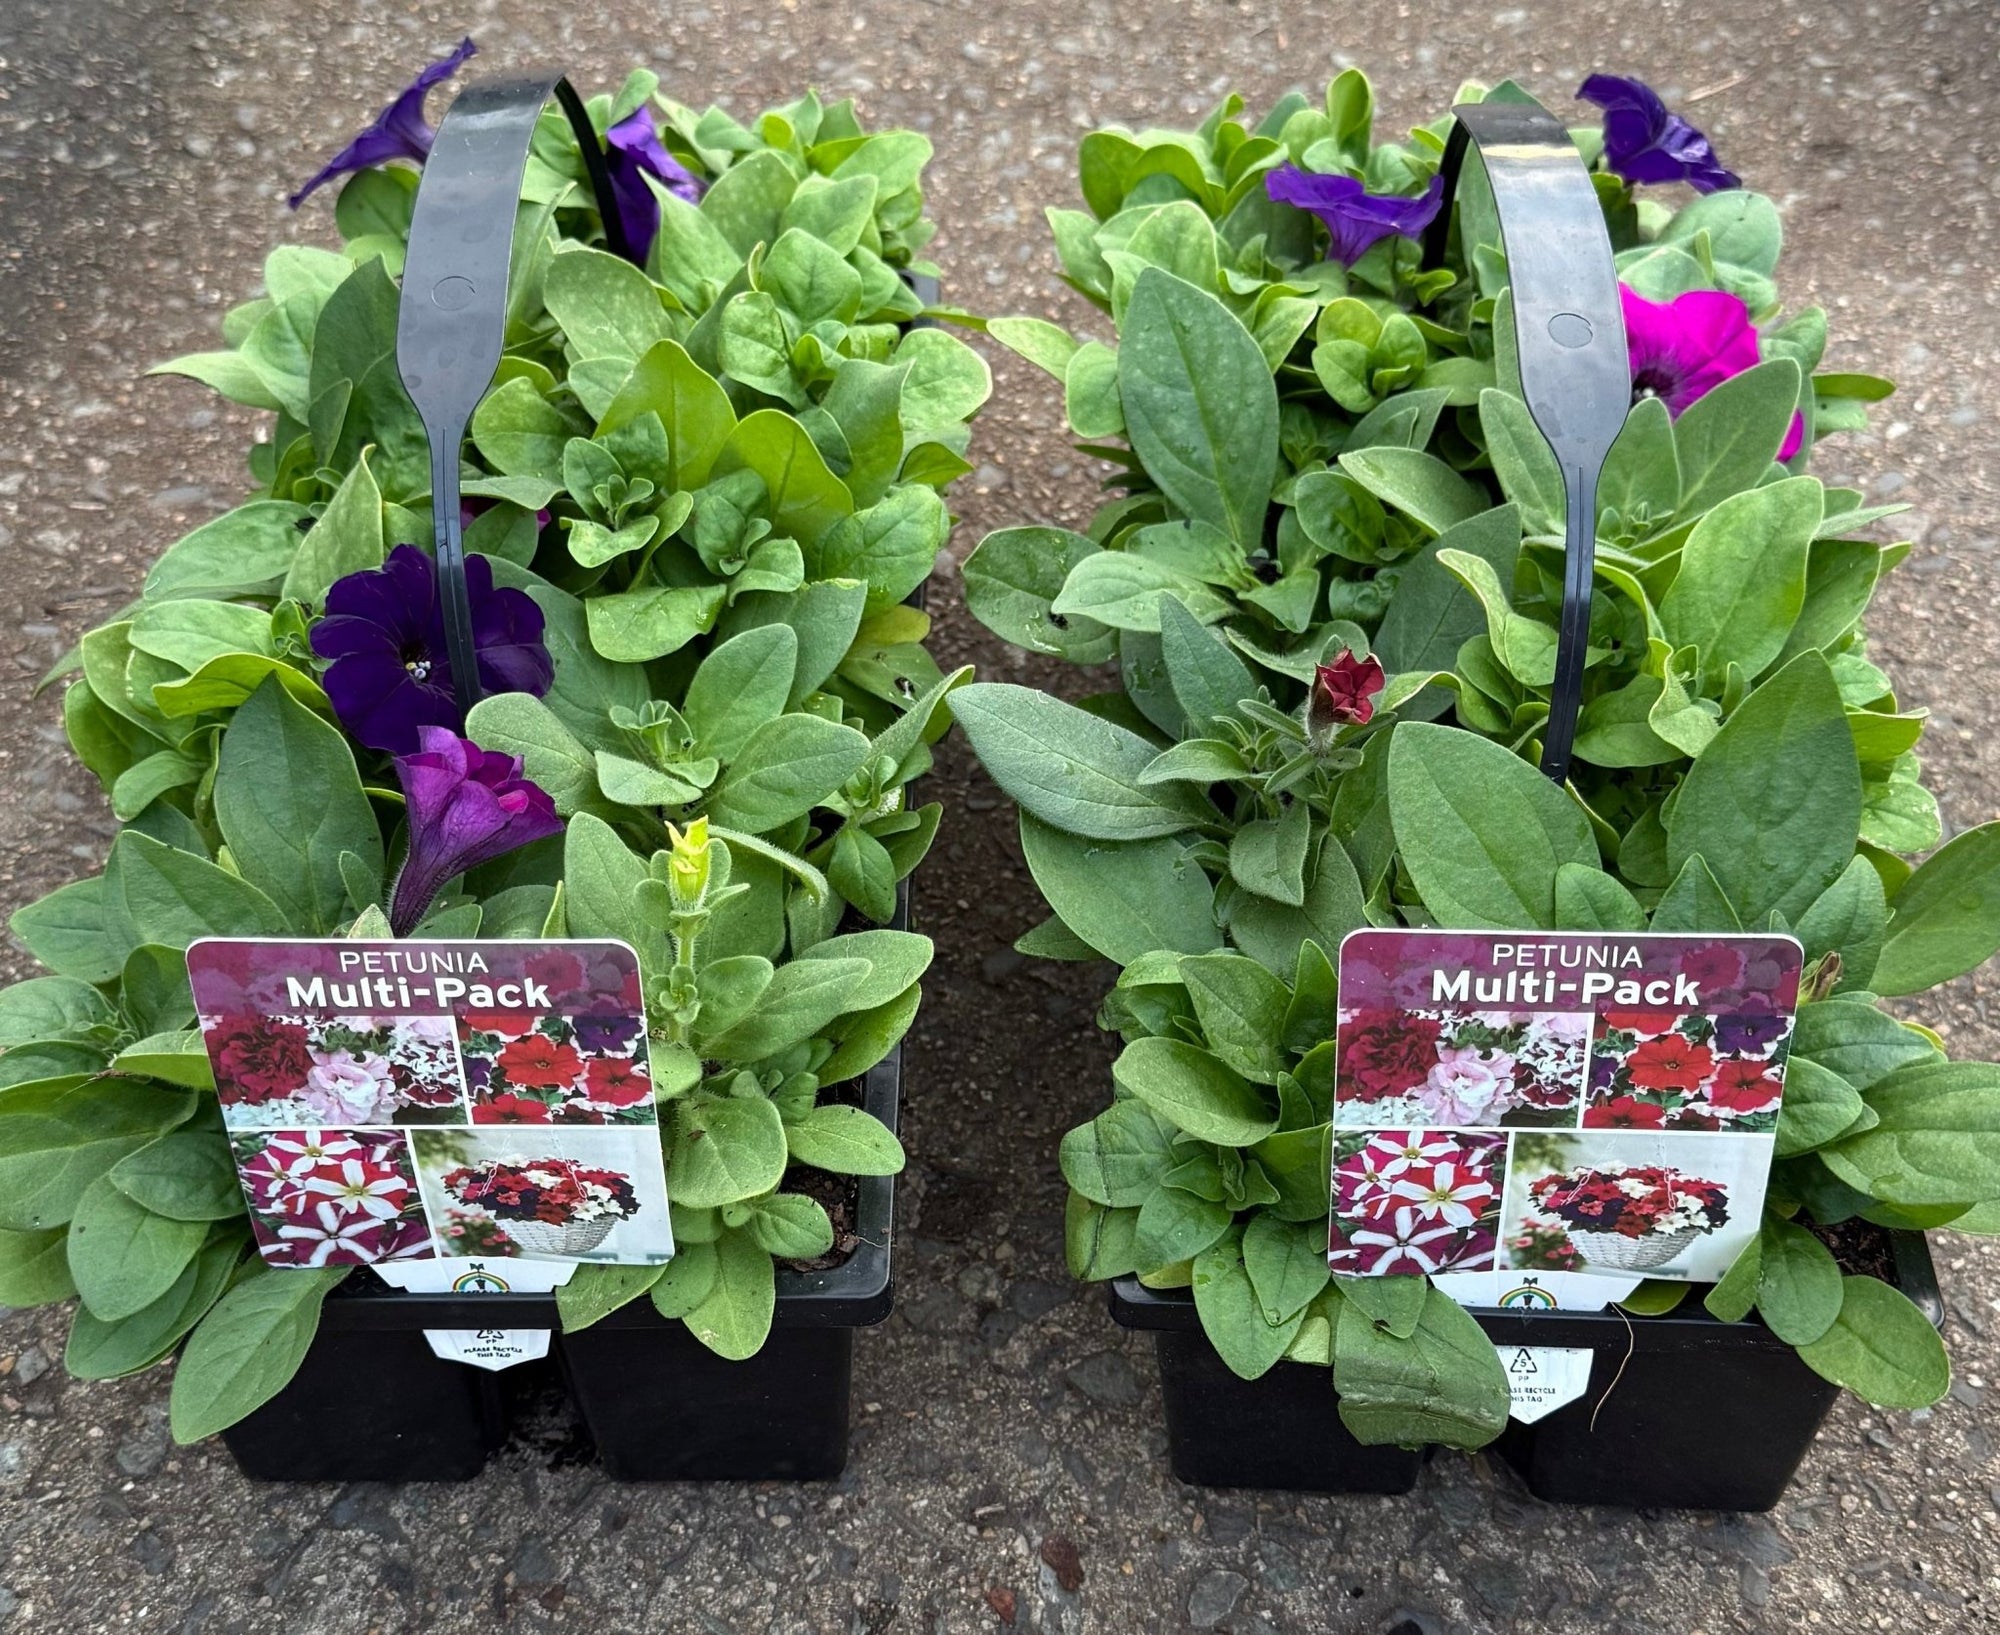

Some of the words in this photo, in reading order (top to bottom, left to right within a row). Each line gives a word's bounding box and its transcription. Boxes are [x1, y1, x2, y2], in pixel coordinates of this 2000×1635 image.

[339, 951, 489, 974] PETUNIA
[1492, 943, 1643, 969] PETUNIA
[286, 976, 552, 1008] Multi-Pack
[1432, 969, 1701, 1006] Multi-Pack
[1520, 1358, 1527, 1368] 5
[1524, 1387, 1556, 1395] RECYCLE
